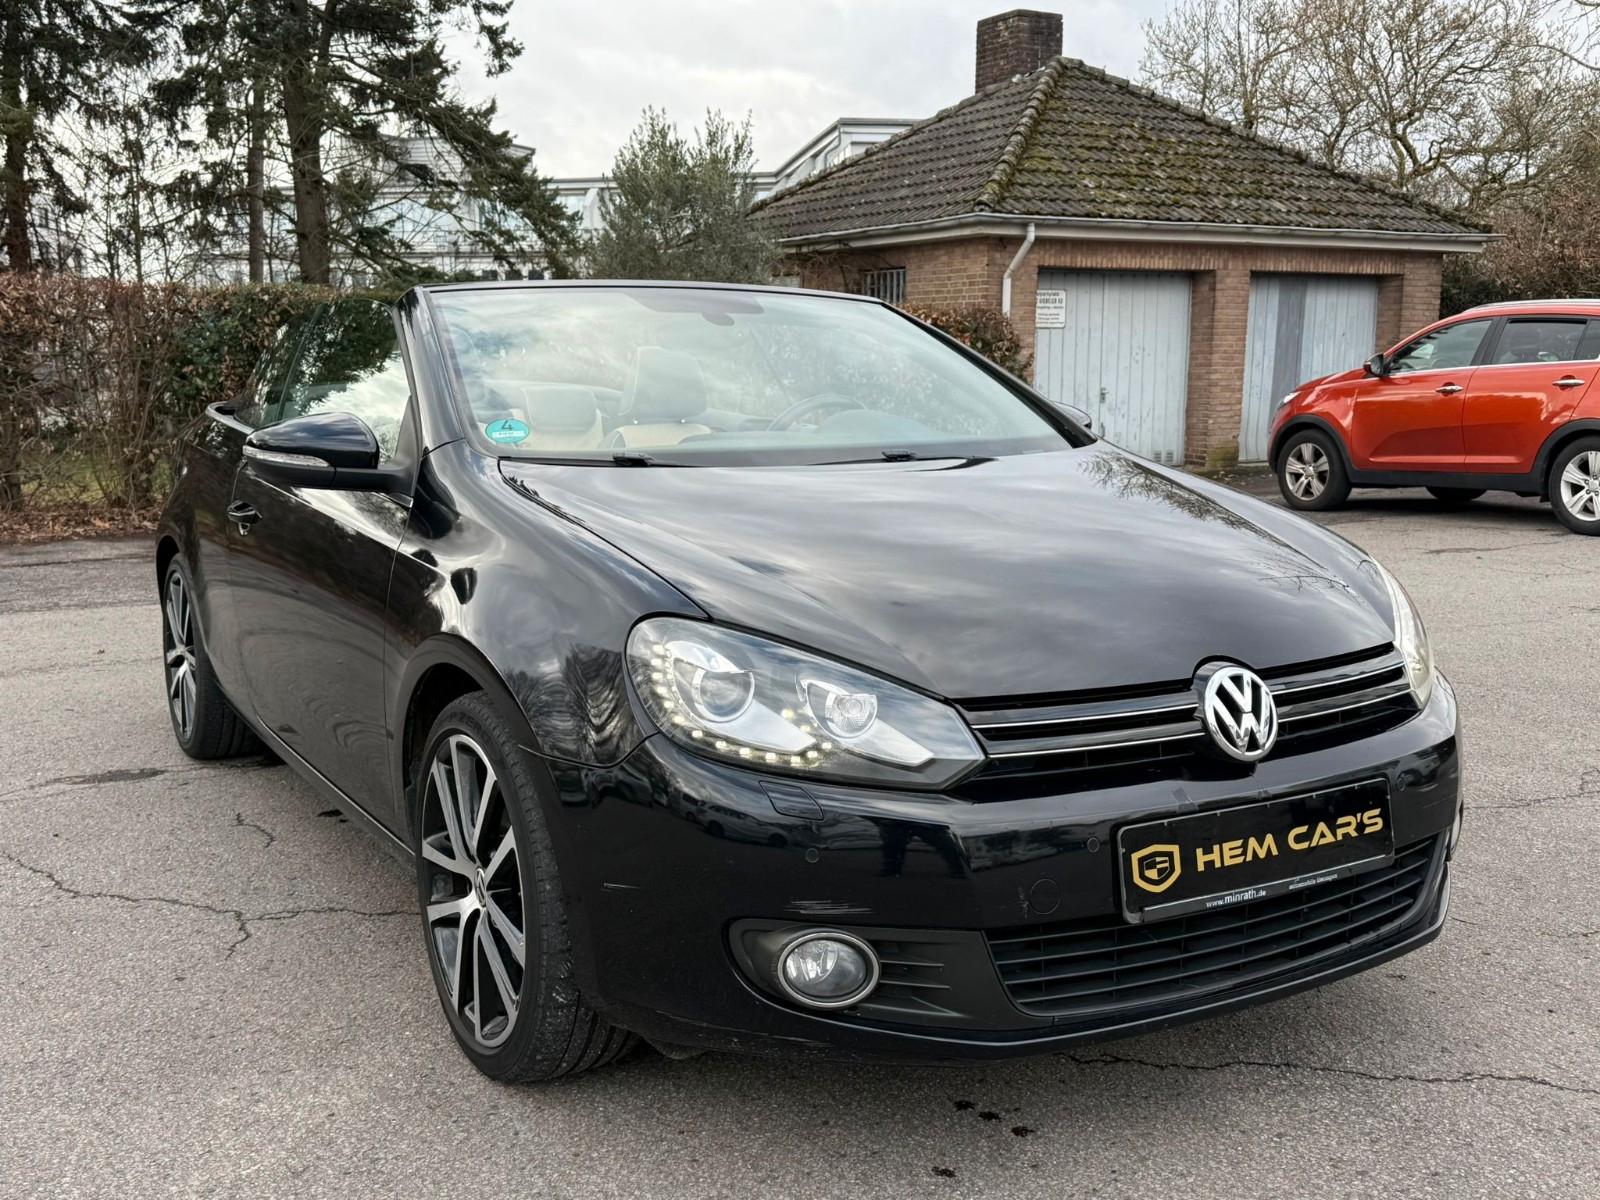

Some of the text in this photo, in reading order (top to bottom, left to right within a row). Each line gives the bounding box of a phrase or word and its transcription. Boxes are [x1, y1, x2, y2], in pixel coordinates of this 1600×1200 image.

[501, 420, 513, 431] 4
[1206, 668, 1276, 758] VW
[1196, 808, 1384, 872] HEM CAR'S
[1206, 888, 1267, 908] www.minrath.de
